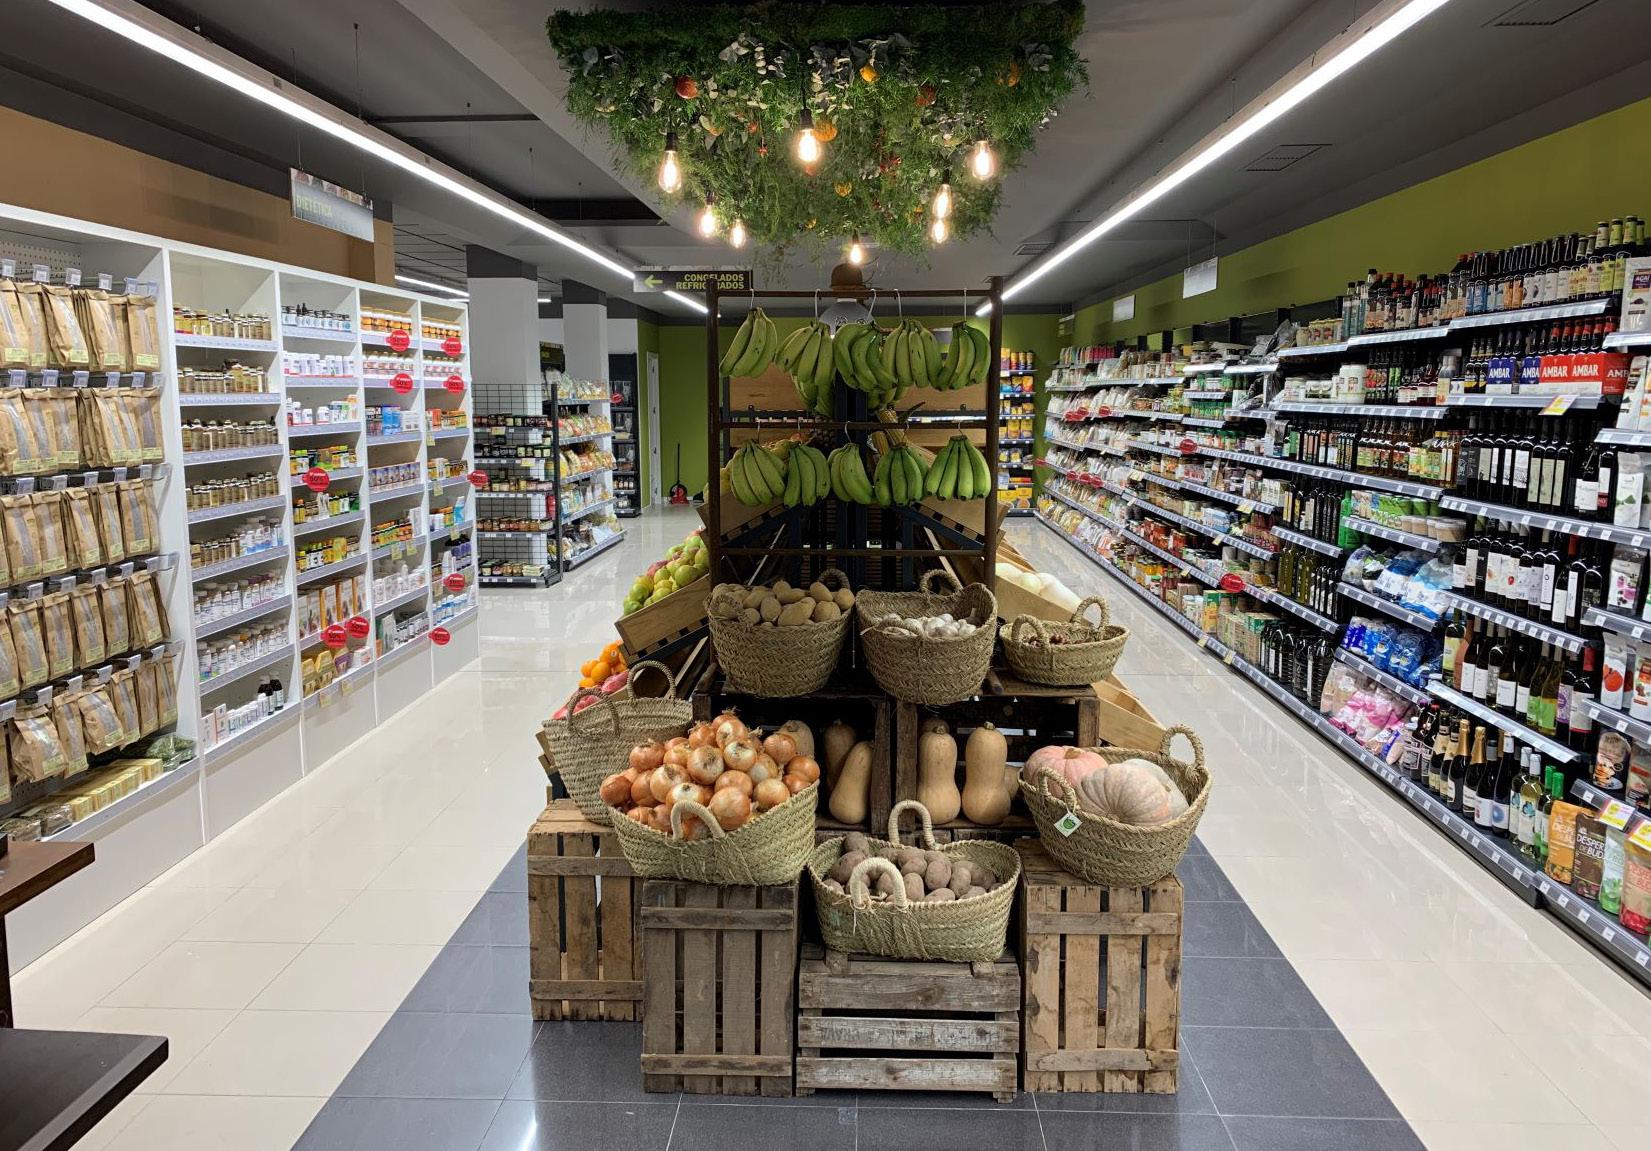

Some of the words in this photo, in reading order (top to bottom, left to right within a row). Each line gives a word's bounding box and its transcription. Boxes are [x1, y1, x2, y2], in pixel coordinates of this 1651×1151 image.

[675, 281, 745, 290] REFRIADOS
[1488, 367, 1510, 378] AMBAR
[1521, 366, 1540, 379] AMBA
[1541, 365, 1569, 378] AMBAR
[1571, 364, 1600, 377] AMBAR
[1607, 369, 1629, 378] AMB
